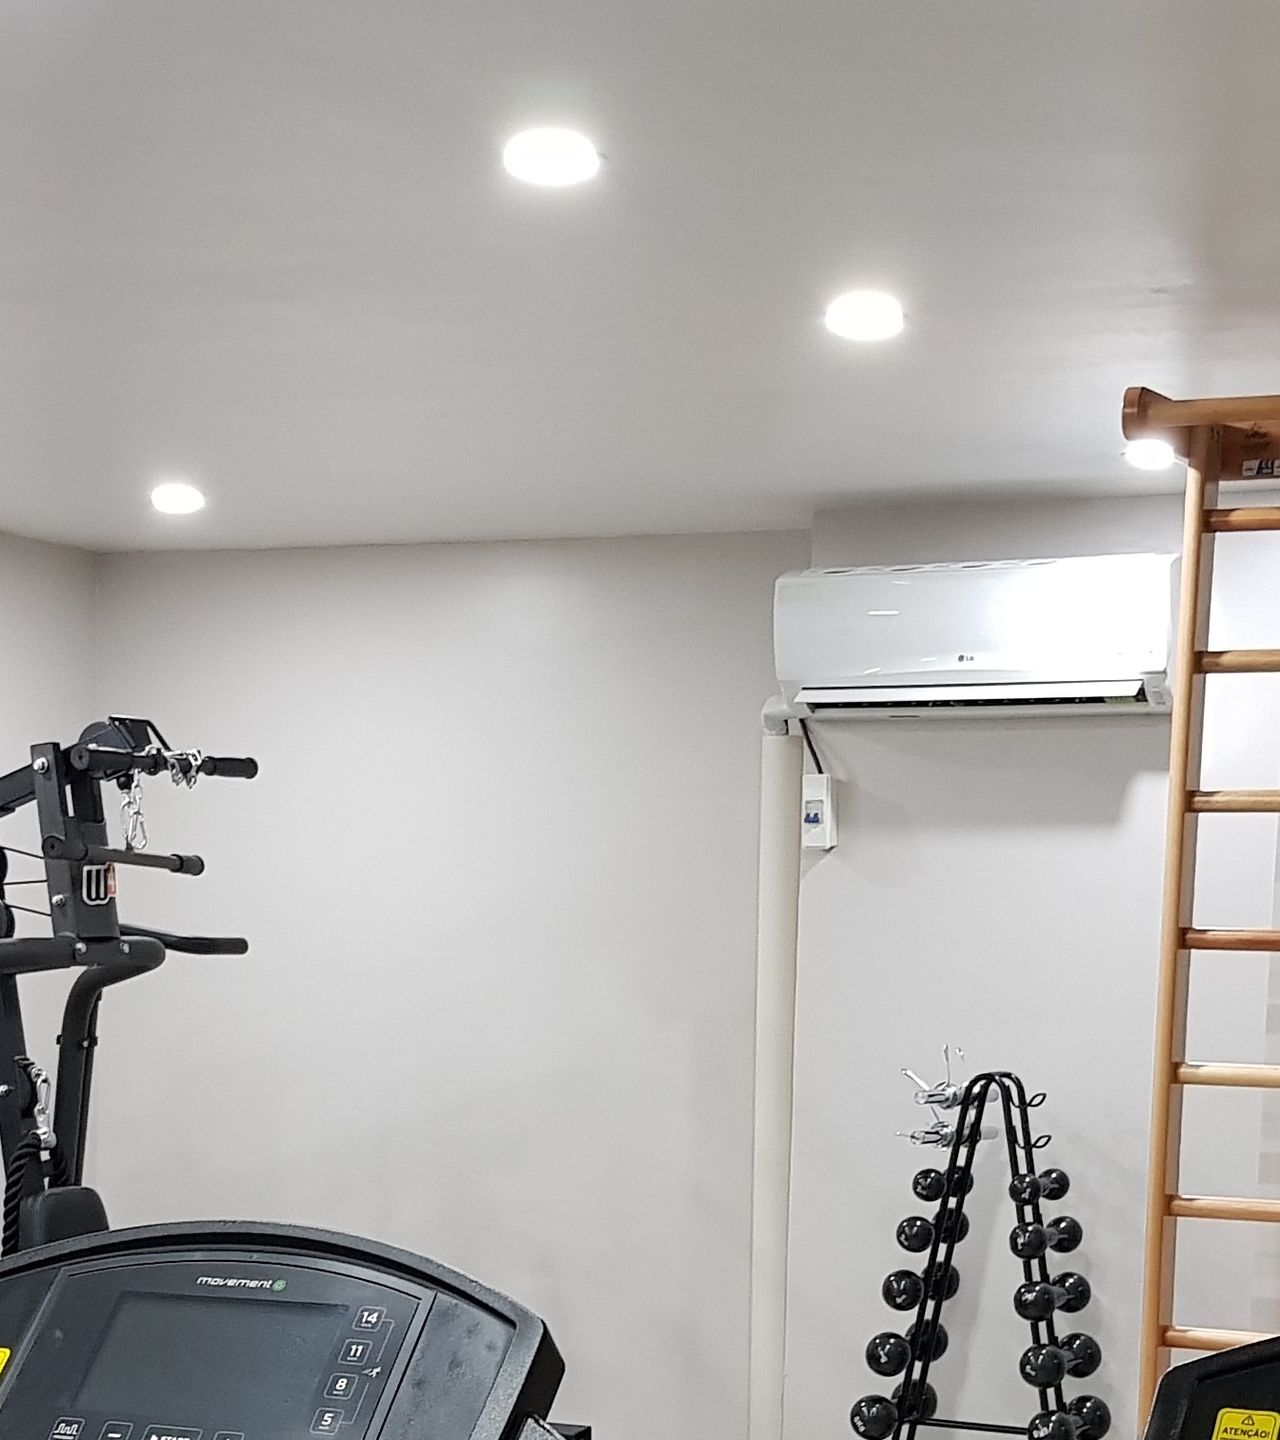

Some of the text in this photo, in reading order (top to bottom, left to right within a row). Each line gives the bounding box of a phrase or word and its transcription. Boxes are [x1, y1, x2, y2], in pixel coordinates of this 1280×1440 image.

[196, 1276, 272, 1289] movement
[361, 1311, 379, 1324] 14
[350, 1345, 363, 1357] 11
[335, 1378, 347, 1390] 8
[321, 1413, 334, 1425] 5
